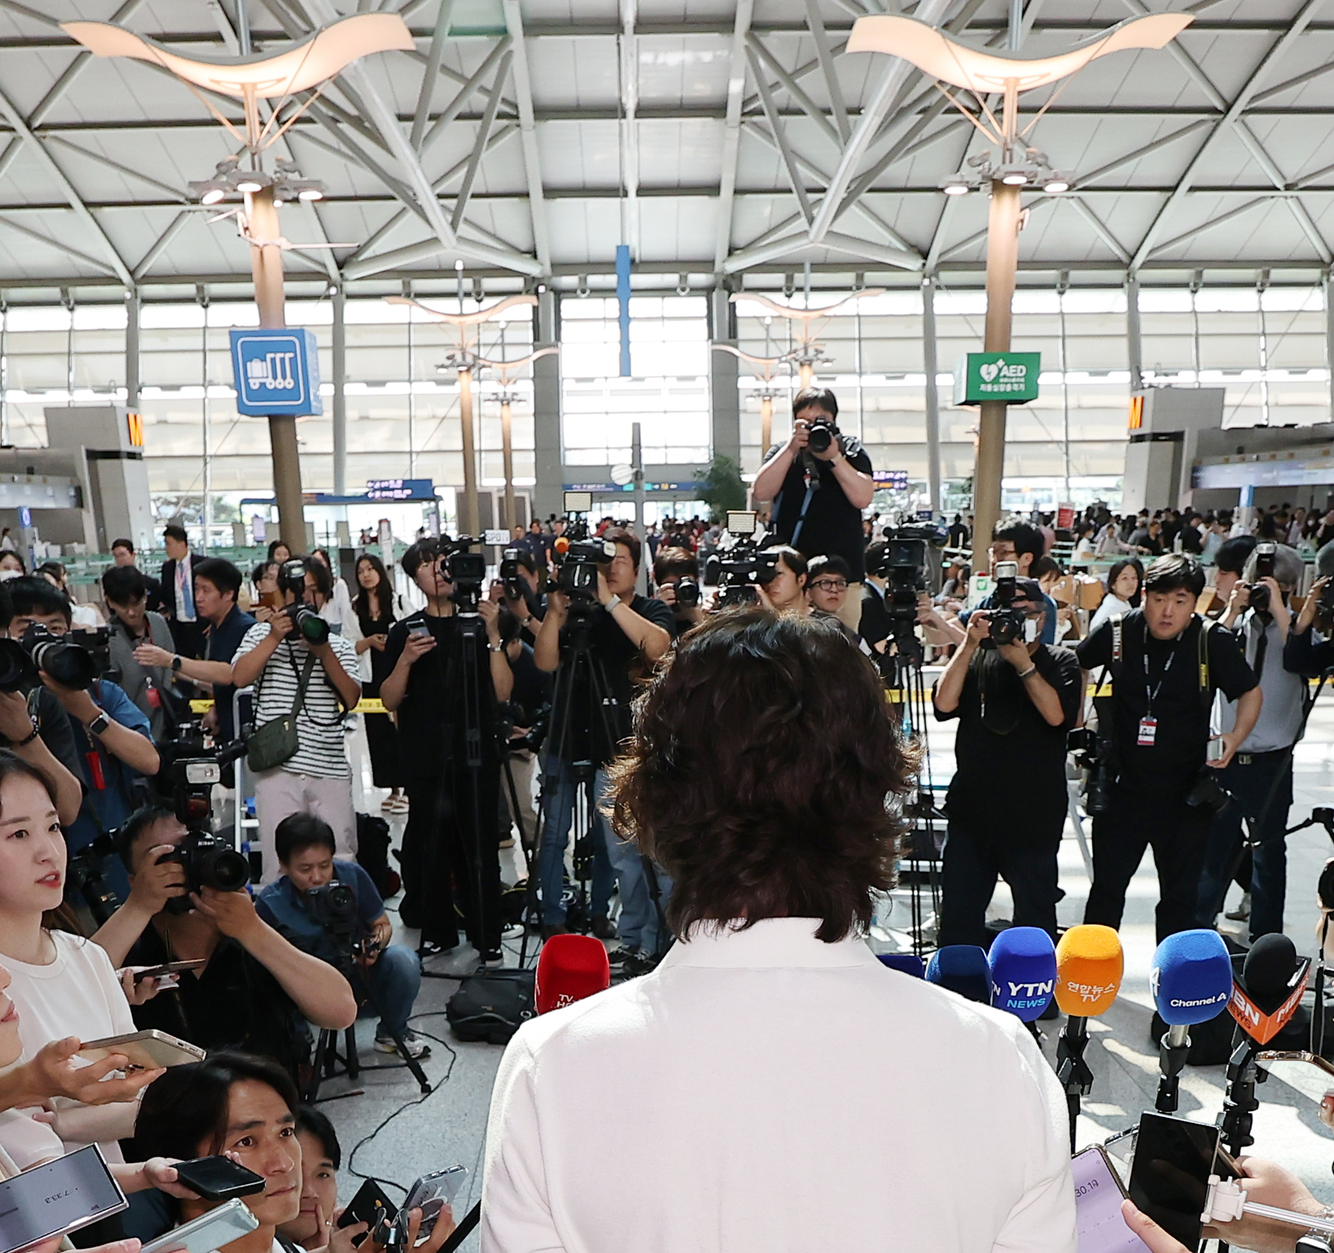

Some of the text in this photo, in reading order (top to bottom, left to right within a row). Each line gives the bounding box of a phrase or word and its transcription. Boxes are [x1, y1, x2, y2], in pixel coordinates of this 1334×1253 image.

[1000, 365, 1027, 377] AED
[1008, 979, 1053, 997] YTN
[1067, 981, 1116, 994] 연합뉴스
[558, 994, 574, 1002] TV
[1007, 998, 1046, 1009] NEWS
[1080, 994, 1101, 1003] TV
[1170, 992, 1228, 1008] Channel A
